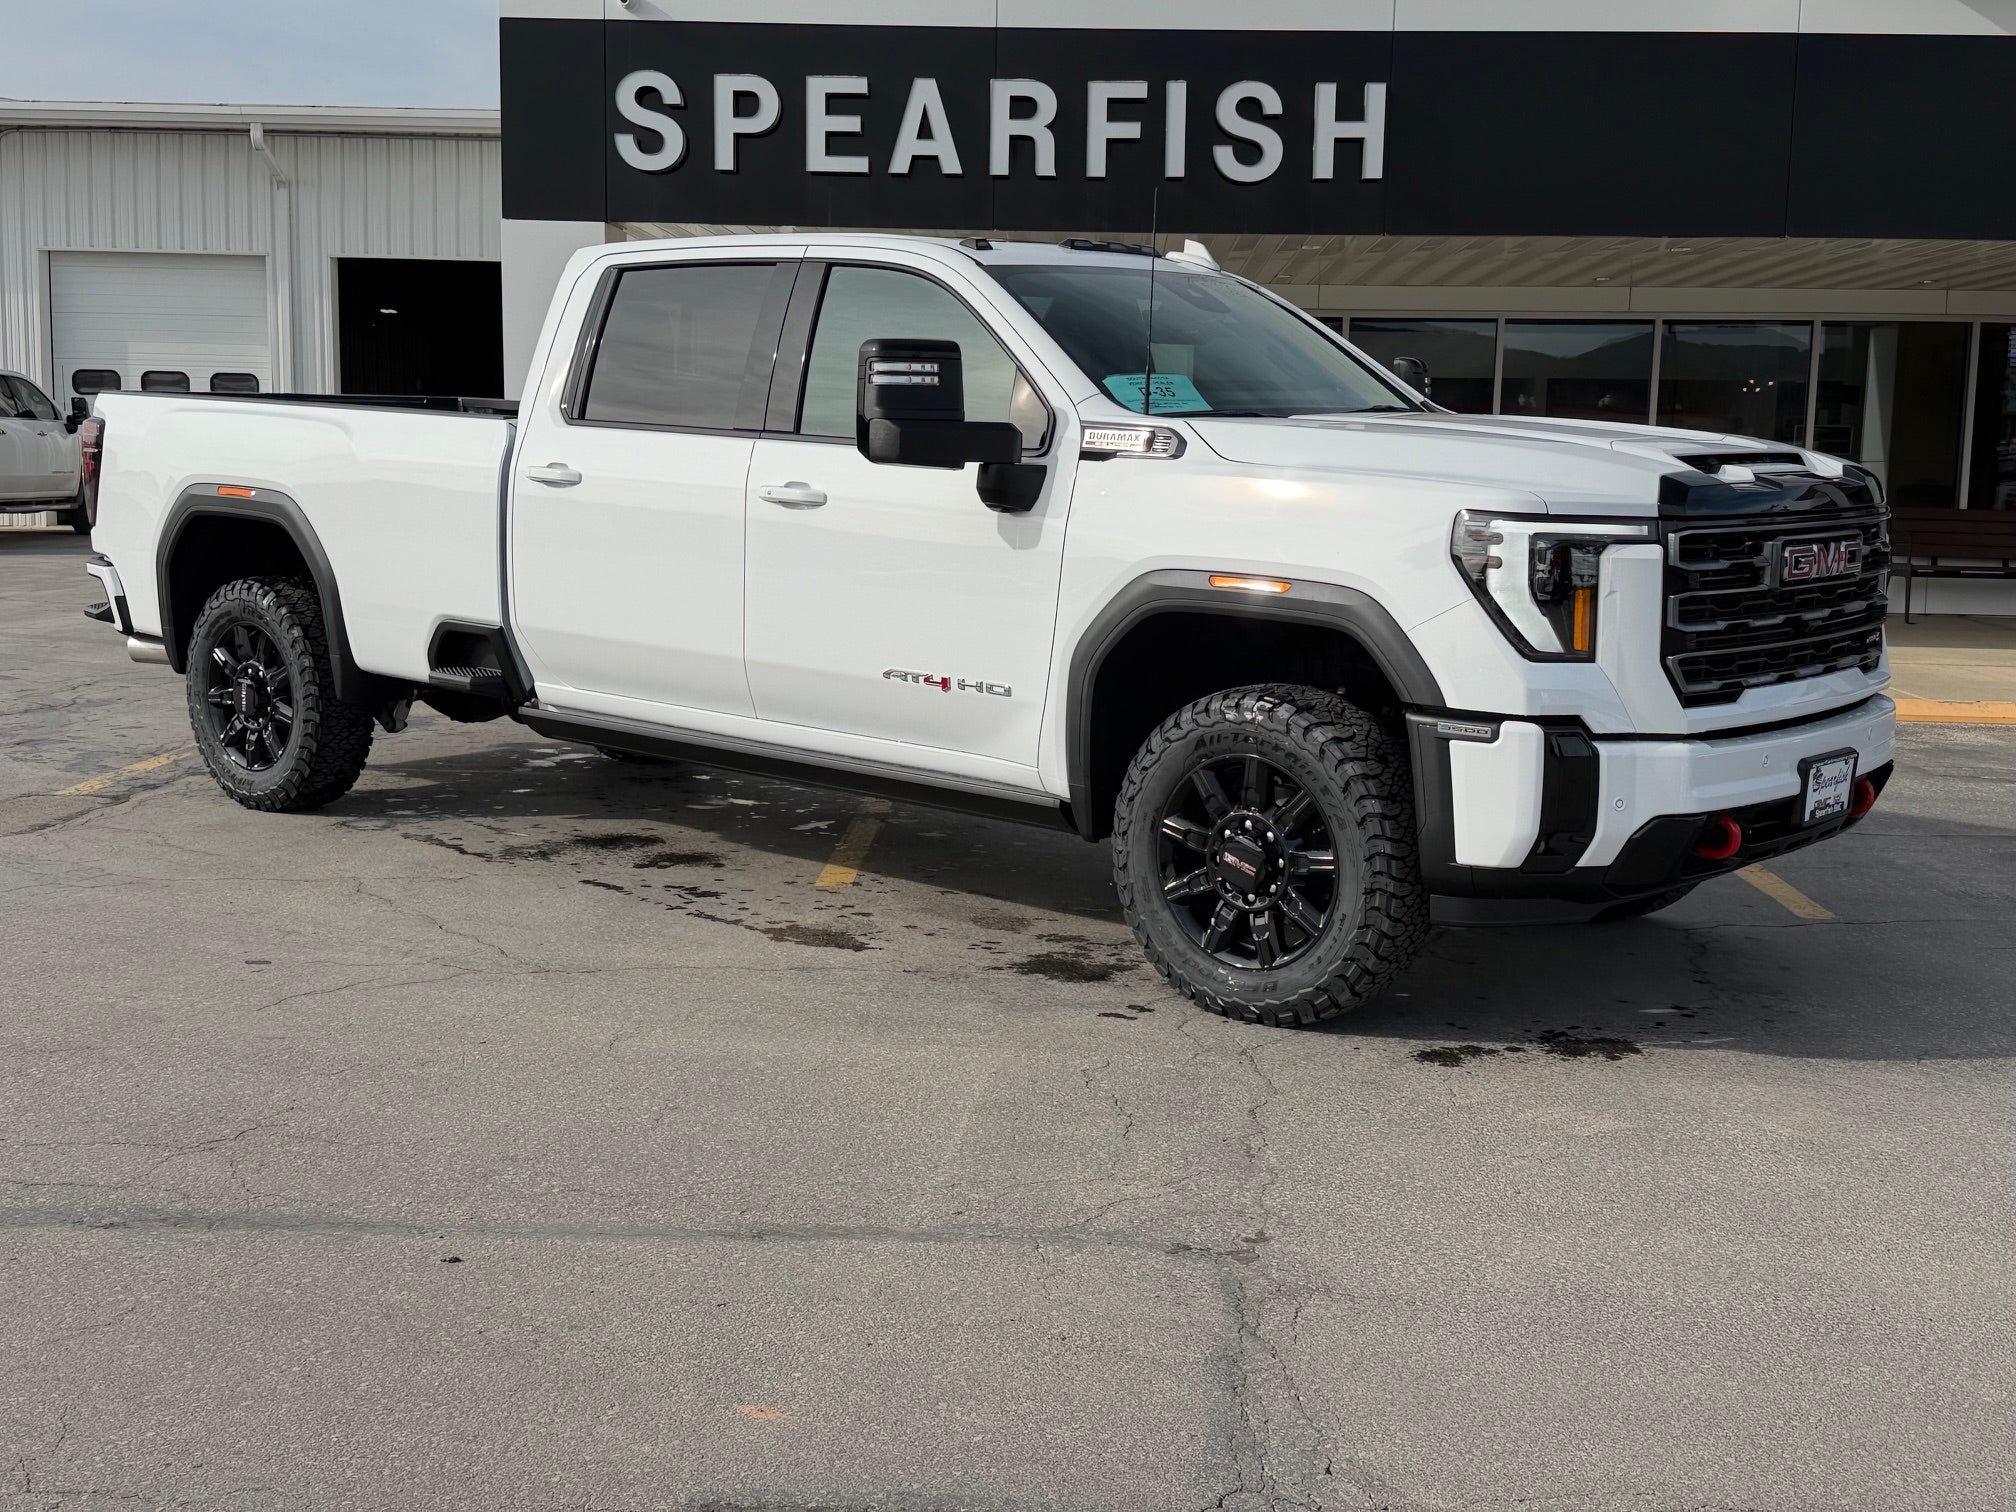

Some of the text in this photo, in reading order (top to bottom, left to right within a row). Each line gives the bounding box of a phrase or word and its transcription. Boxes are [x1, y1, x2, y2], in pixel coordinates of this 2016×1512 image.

[613, 69, 1388, 183] SPEARFISH
[1089, 431, 1141, 441] DURAMAX
[1783, 541, 1862, 580] GMC
[883, 668, 1012, 698] AT4 HD
